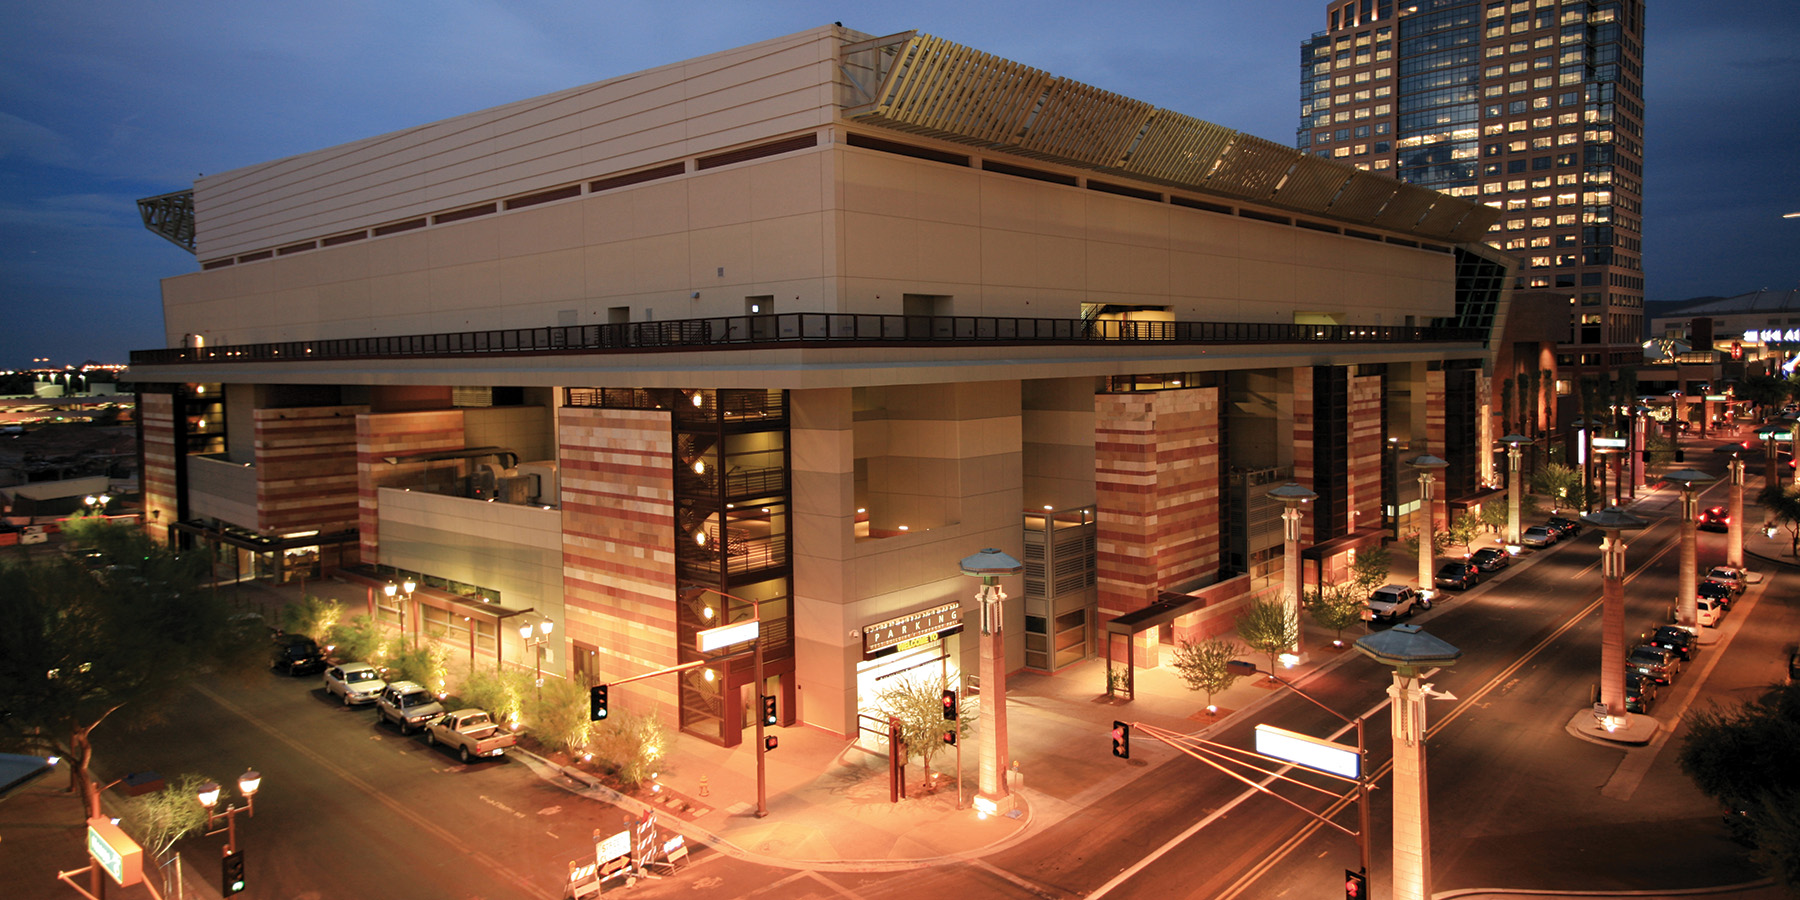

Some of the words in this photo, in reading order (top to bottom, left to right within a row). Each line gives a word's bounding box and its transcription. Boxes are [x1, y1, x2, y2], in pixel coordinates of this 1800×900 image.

[874, 611, 957, 642] PARKING
[896, 635, 929, 652] WELCOME
[930, 632, 939, 642] TO
